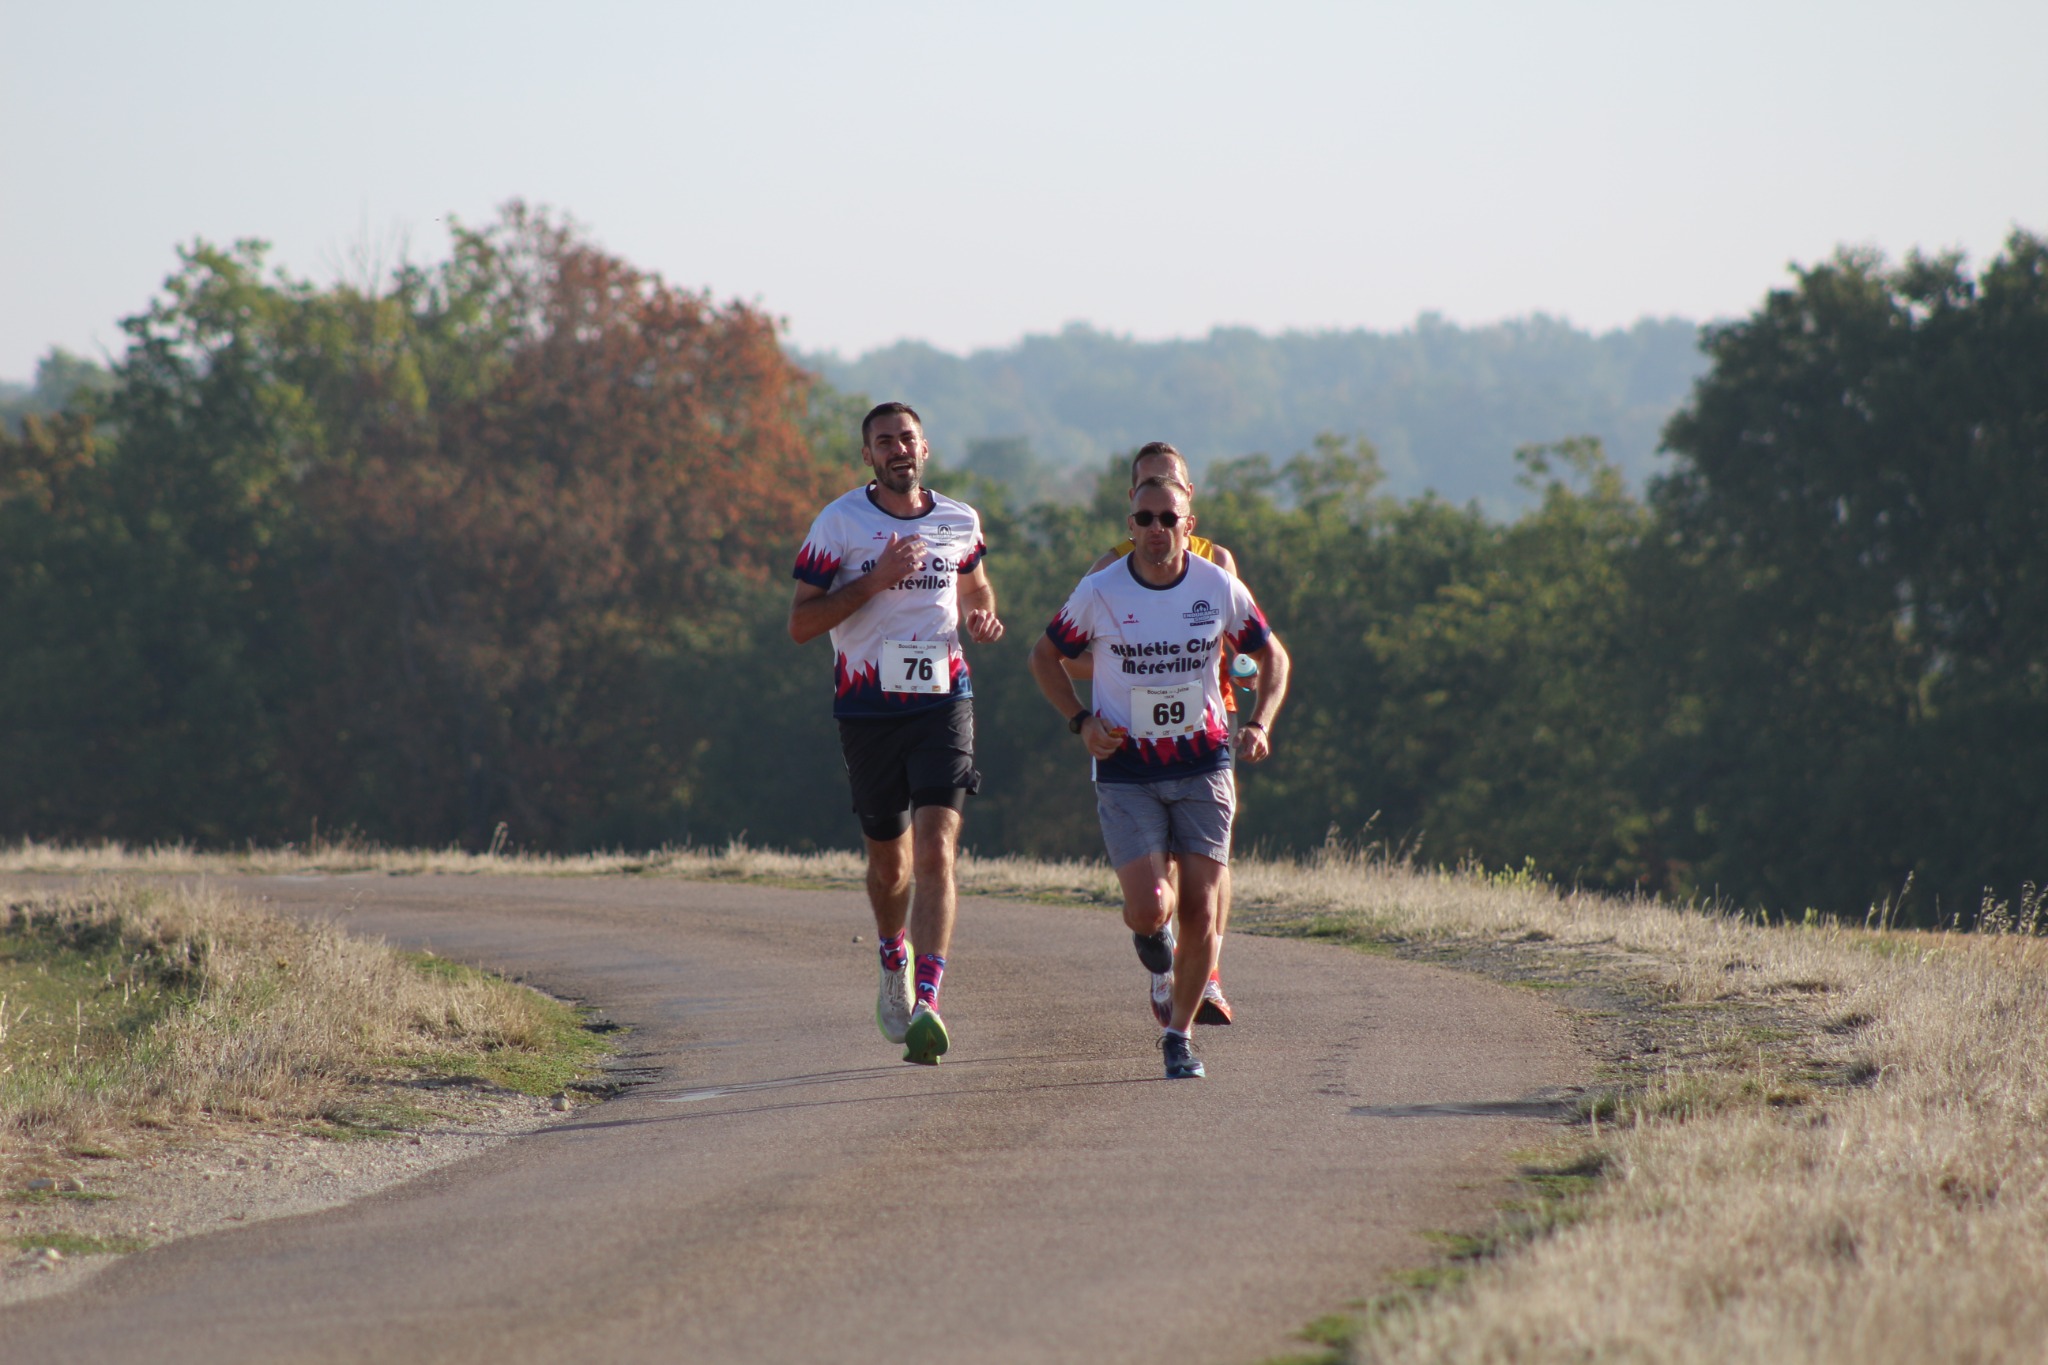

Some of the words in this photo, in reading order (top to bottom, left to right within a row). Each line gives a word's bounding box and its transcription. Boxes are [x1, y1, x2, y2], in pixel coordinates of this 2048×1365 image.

[1110, 641, 1181, 657] Athlétic
[903, 657, 933, 681] 76
[1153, 700, 1185, 726] 69
